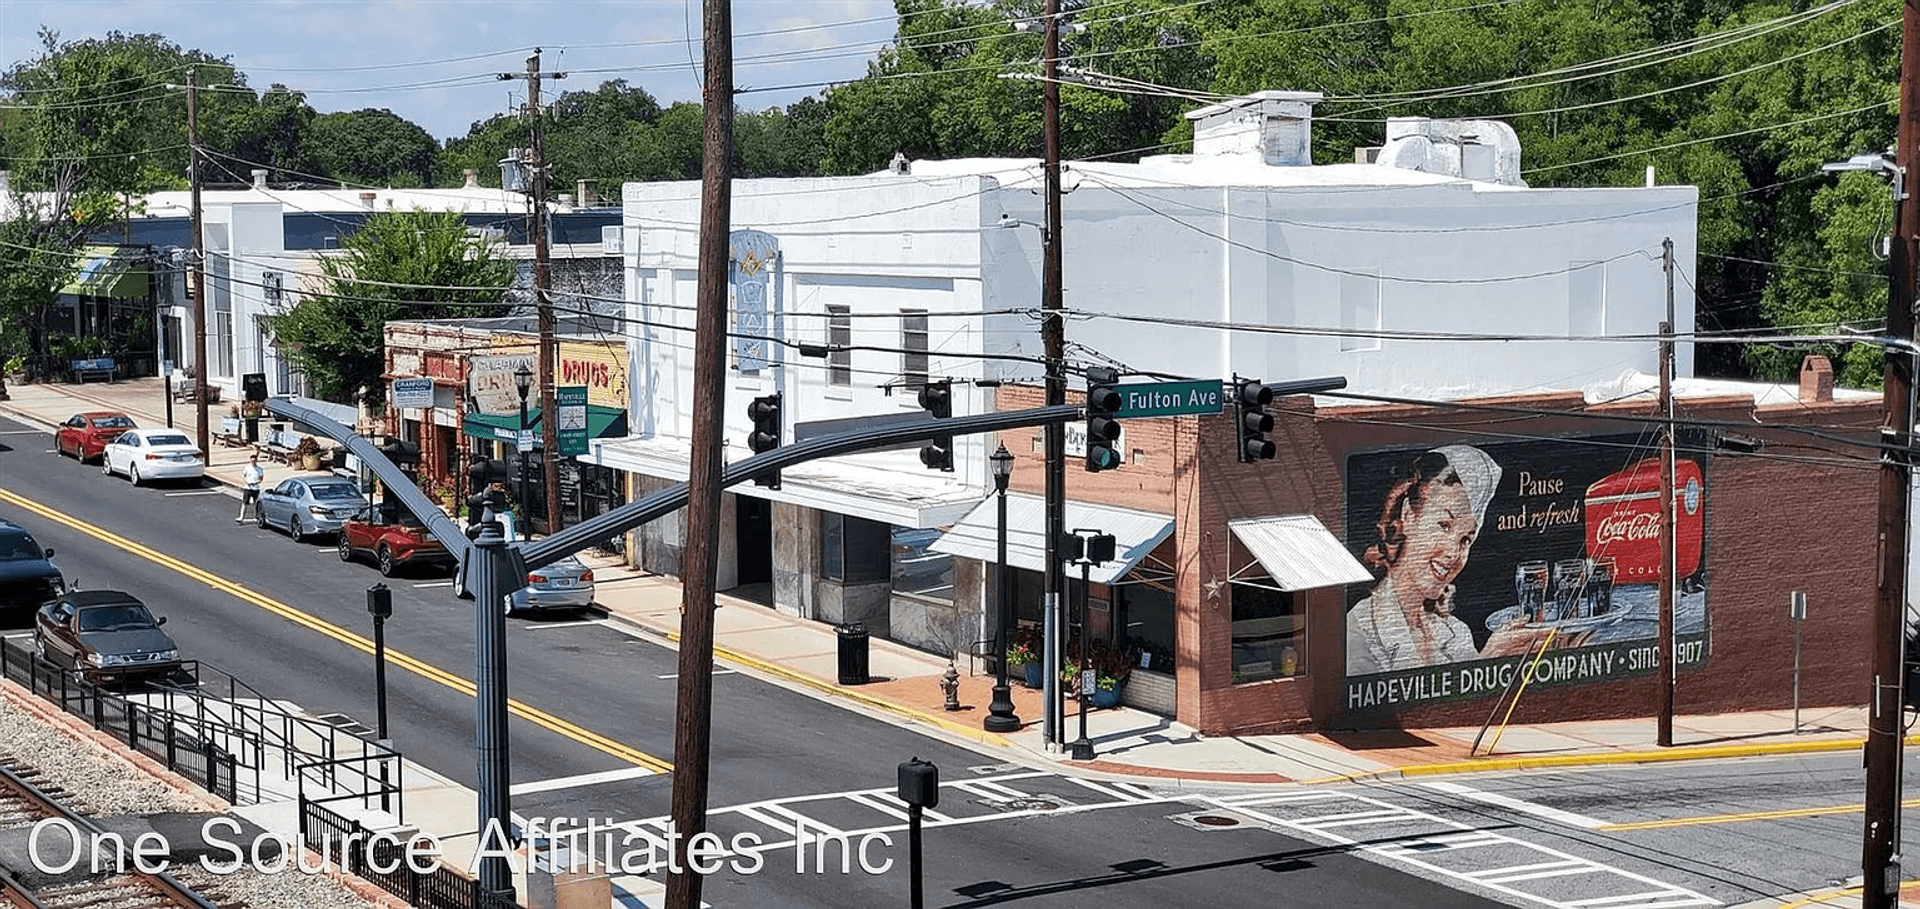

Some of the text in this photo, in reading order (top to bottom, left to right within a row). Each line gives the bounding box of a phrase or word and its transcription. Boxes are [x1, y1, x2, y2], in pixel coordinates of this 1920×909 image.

[563, 359, 608, 387] DRUGS
[1129, 391, 1181, 410] Fulton
[1188, 388, 1217, 406] Ave
[1518, 471, 1564, 496] Pause
[1498, 499, 1580, 534] and refresh
[1596, 512, 1661, 544] Coca-Cola
[1348, 640, 1703, 709] HAPEVILLE DRUG COMPANY SINC 907
